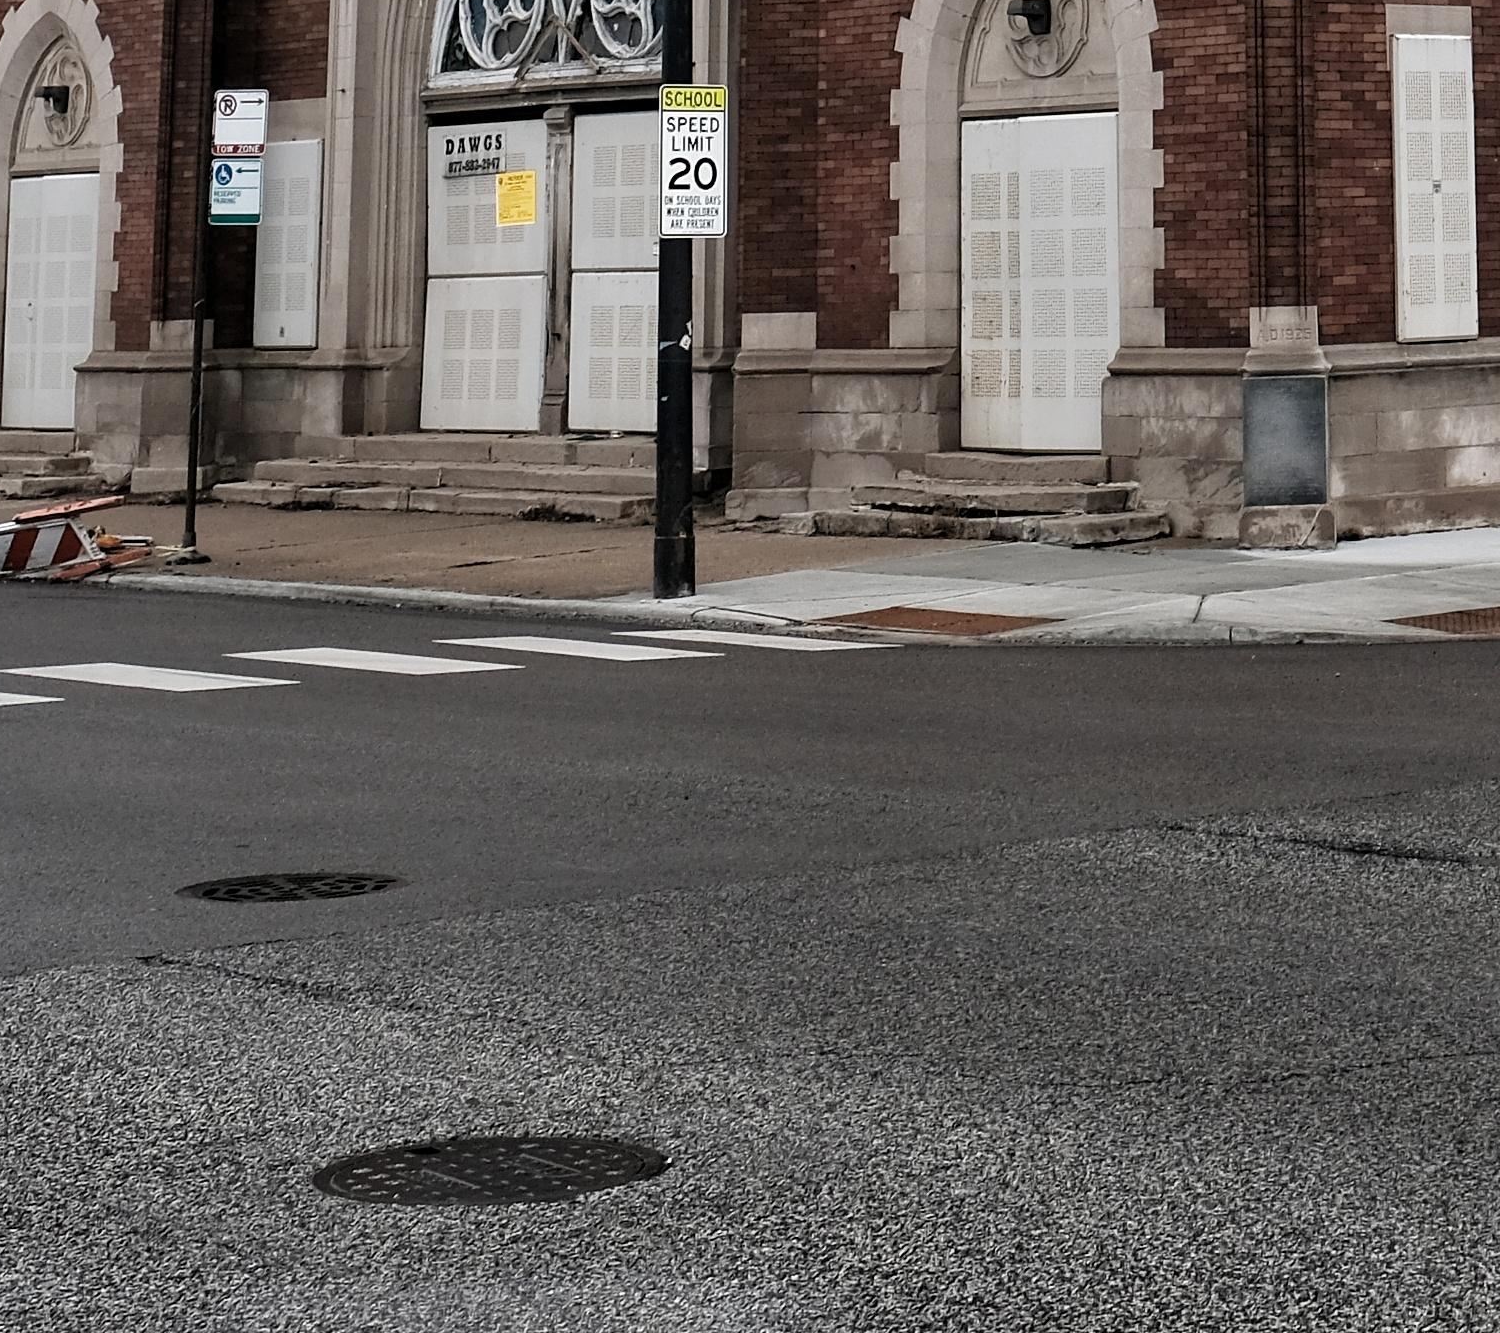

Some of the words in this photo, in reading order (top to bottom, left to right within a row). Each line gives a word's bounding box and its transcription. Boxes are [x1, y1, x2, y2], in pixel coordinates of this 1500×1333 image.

[665, 91, 722, 107] SCHOOL
[667, 117, 720, 133] SPEED
[217, 145, 234, 153] TOW
[238, 145, 261, 153] ZONE
[445, 134, 502, 155] DAWGS
[672, 136, 714, 152] LIMIT
[668, 157, 717, 190] 20
[664, 195, 673, 205] ON
[676, 195, 702, 205] SCHOOL
[705, 195, 721, 205] DAYS
[666, 208, 684, 217] WHEN
[688, 208, 719, 217] CHILDREN
[670, 219, 683, 229] ARE
[687, 219, 714, 229] PRESENT
